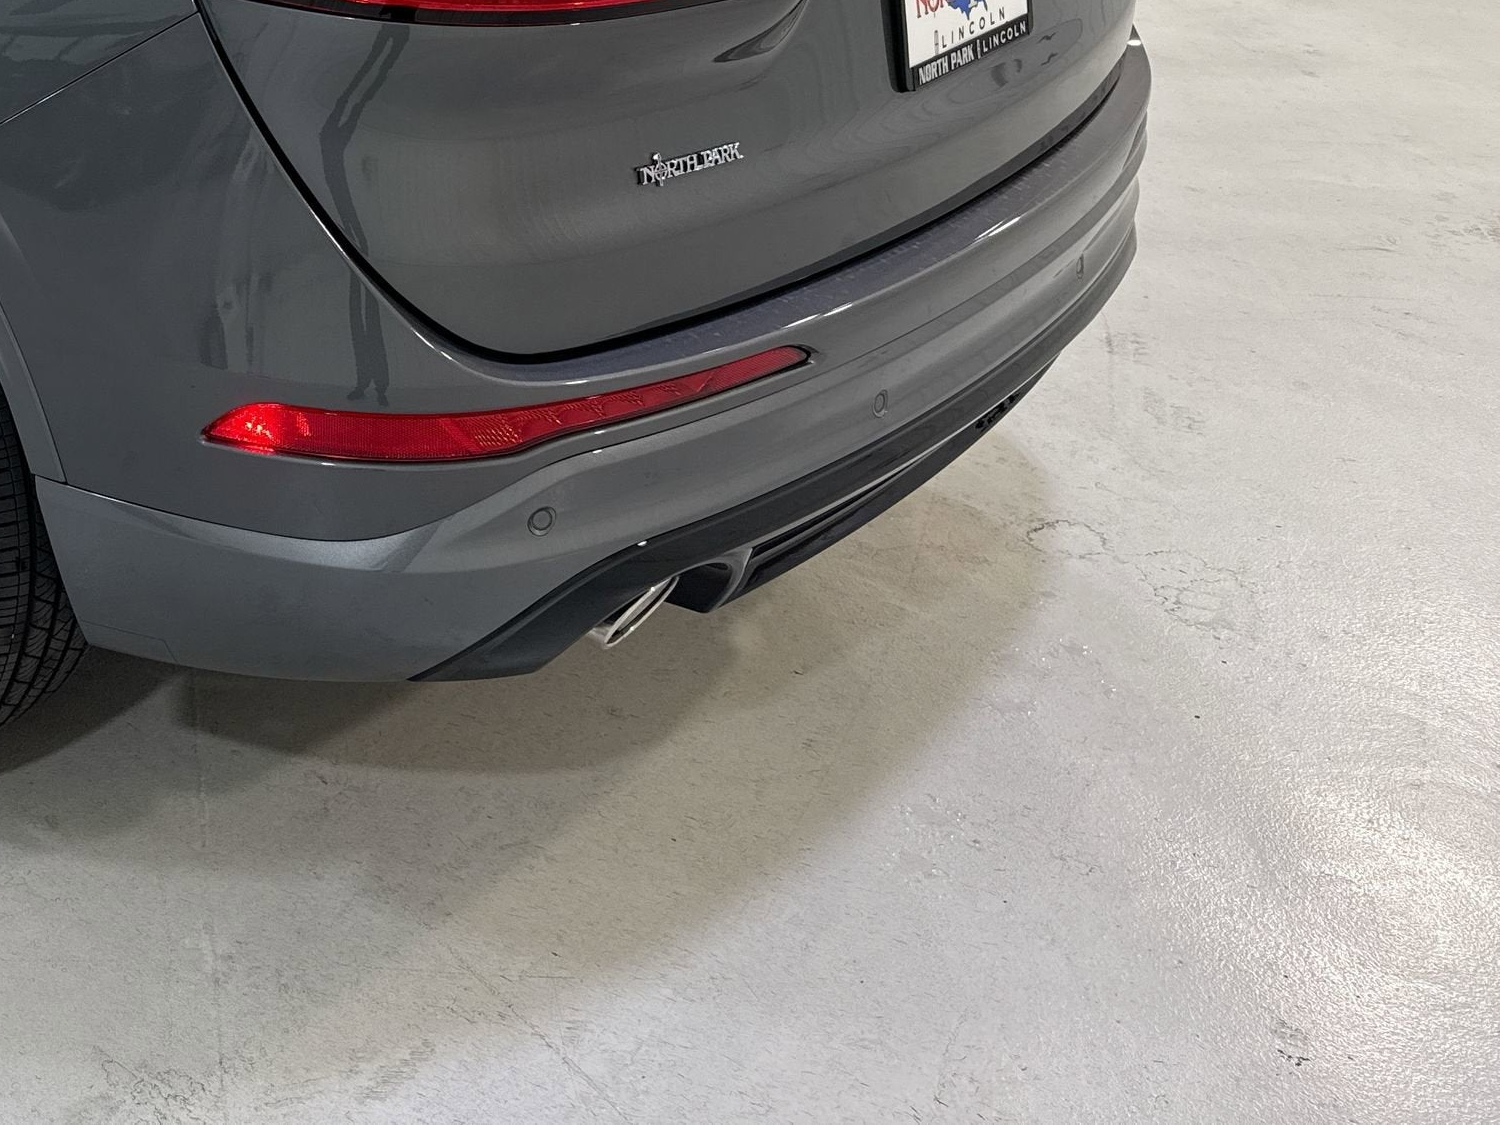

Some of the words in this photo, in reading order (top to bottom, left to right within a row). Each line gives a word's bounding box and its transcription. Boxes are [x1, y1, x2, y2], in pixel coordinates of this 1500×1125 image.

[941, 7, 1005, 49] LINCOLN
[918, 56, 949, 85] NORTH
[951, 43, 975, 70] PARK
[982, 20, 1026, 53] LINCOLN
[638, 153, 702, 186] NORTH
[701, 141, 744, 168] PARK
